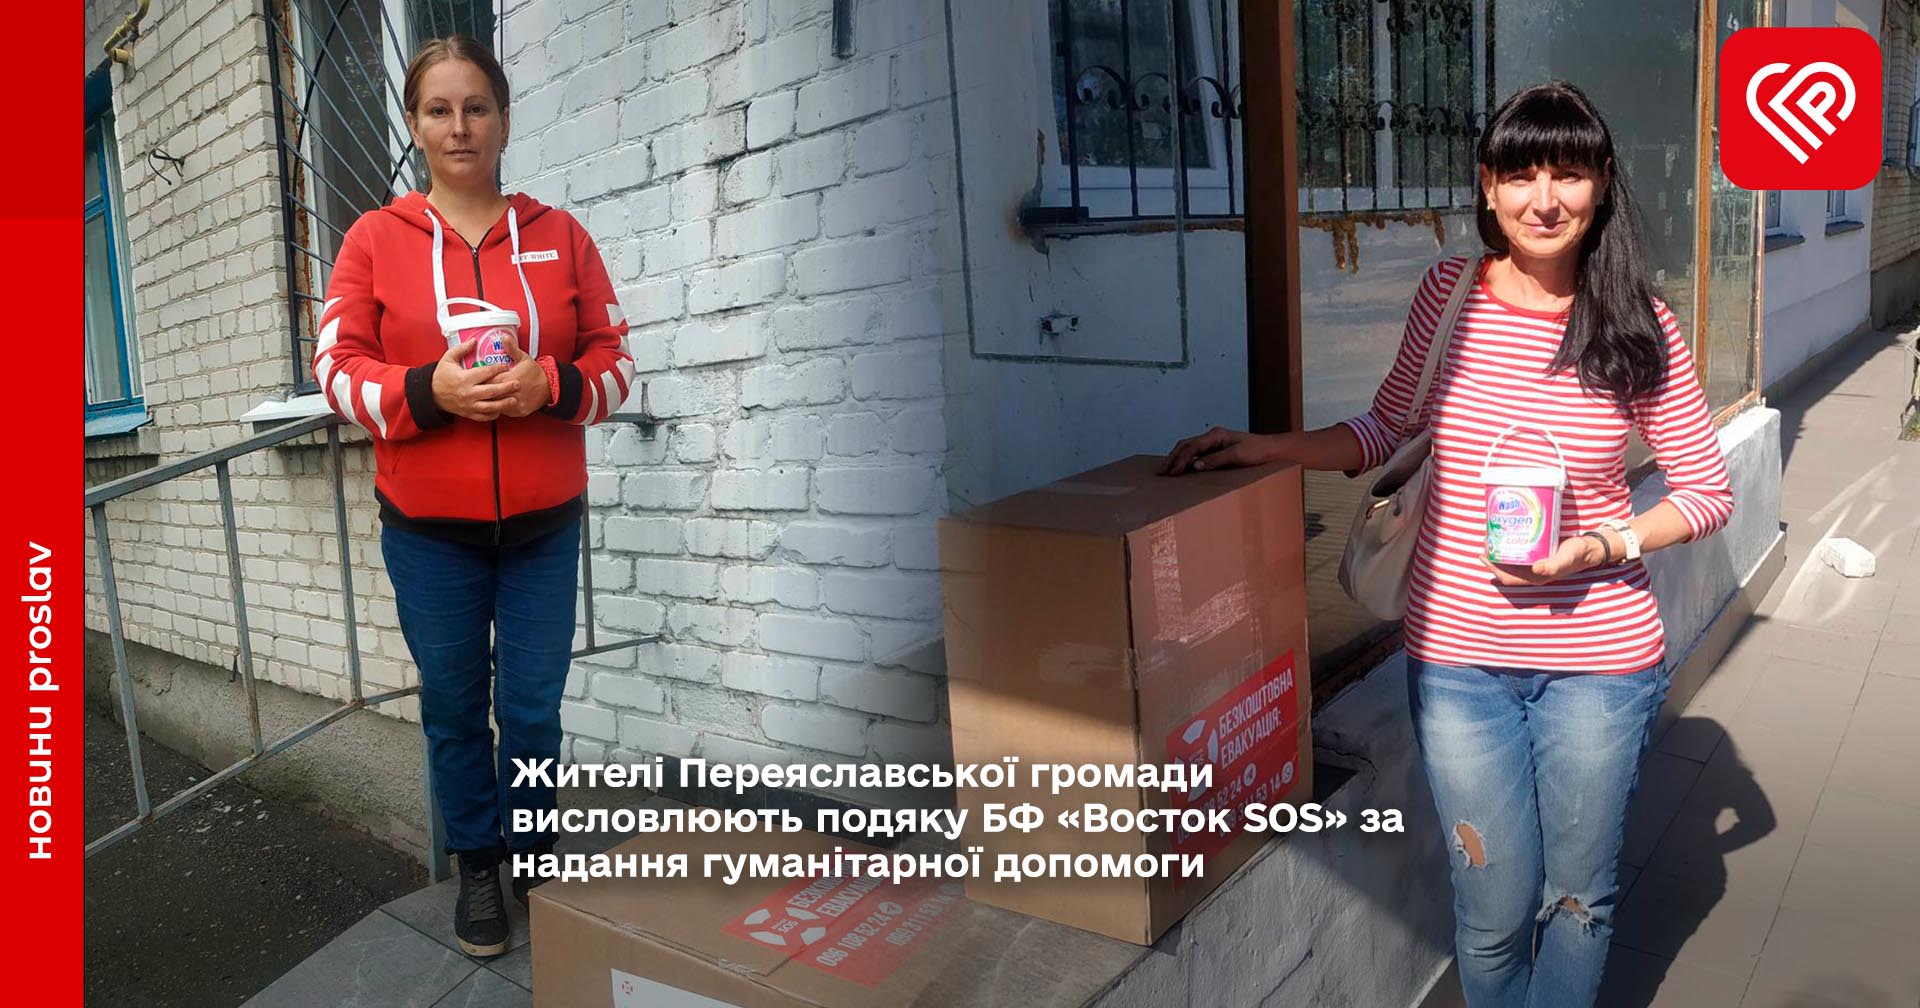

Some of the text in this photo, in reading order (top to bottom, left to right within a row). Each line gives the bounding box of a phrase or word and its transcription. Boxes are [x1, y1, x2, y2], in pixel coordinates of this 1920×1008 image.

[1491, 514, 1533, 527] oxygen
[1498, 499, 1521, 511] Wash
[1219, 667, 1294, 739] БЕЗКОШТОВНА
[1221, 706, 1282, 769] ЕВАКУАЦІЯ:
